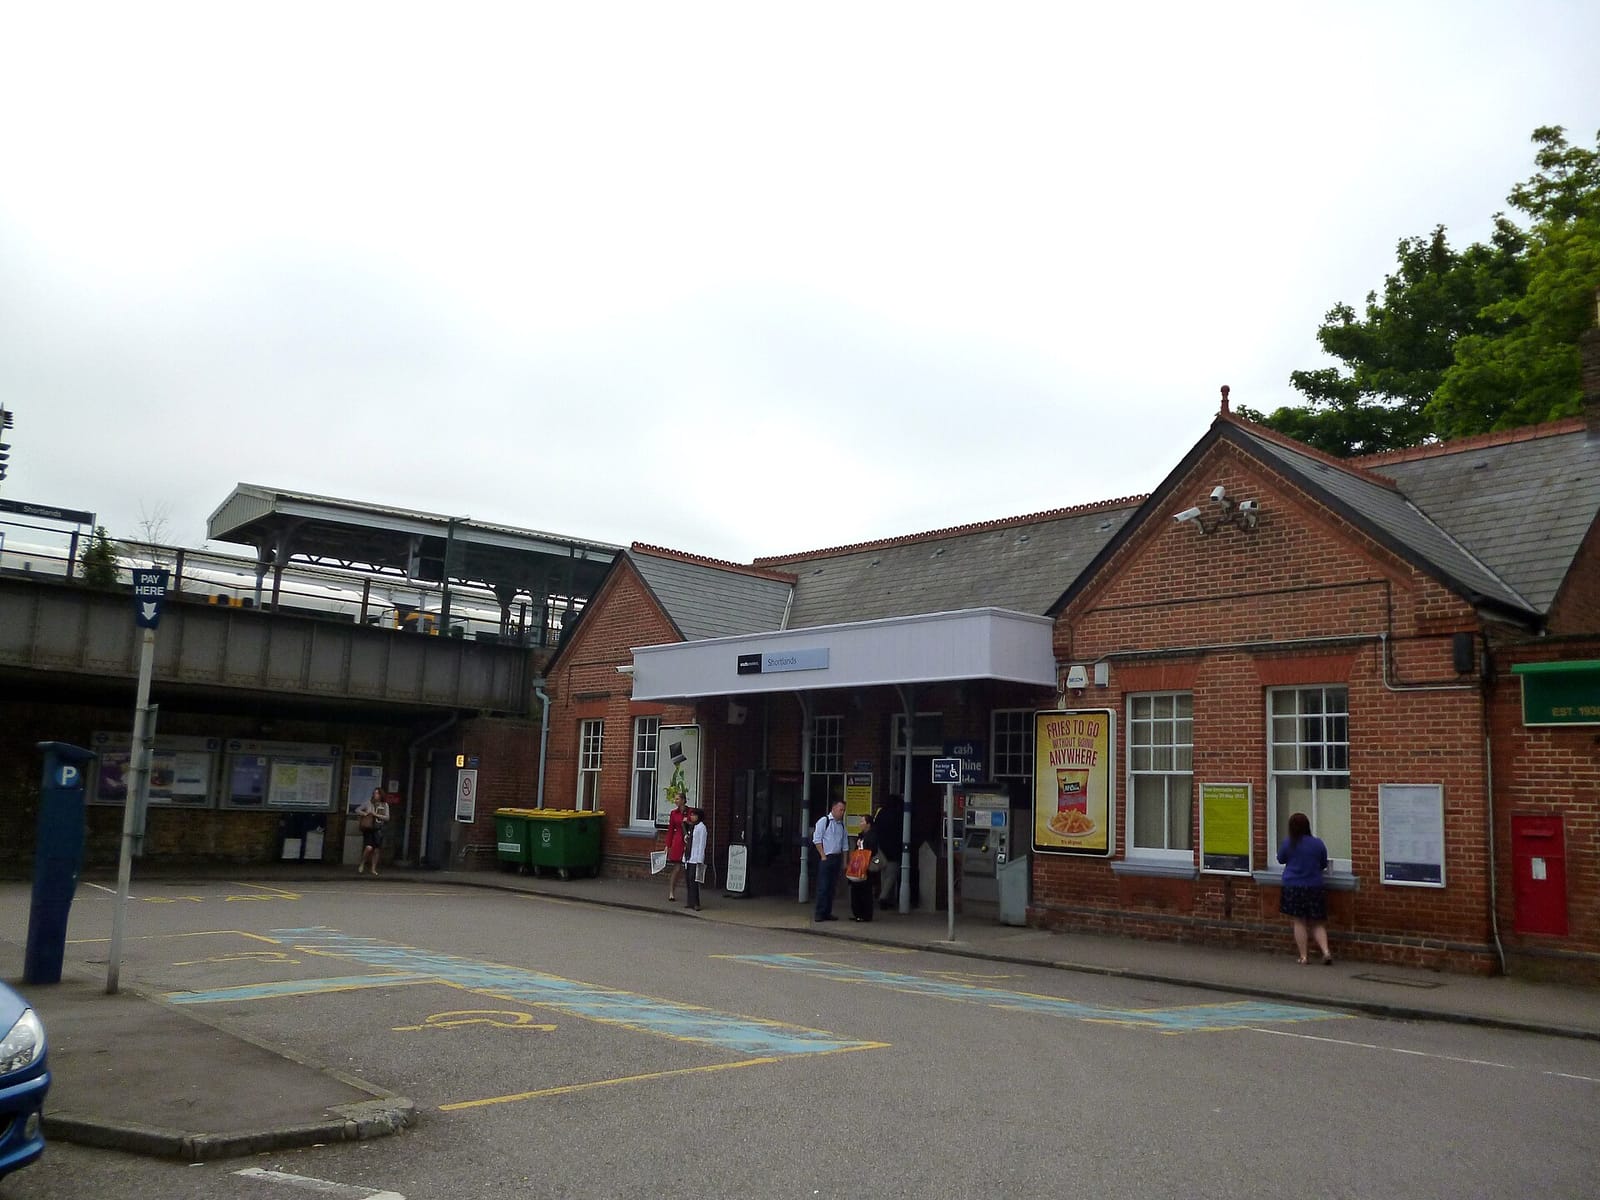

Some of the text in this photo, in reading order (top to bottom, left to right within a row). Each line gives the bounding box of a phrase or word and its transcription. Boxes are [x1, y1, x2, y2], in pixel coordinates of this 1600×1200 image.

[23, 505, 62, 517] Shortlands
[141, 574, 160, 584] PAY
[135, 585, 165, 596] HERE
[767, 656, 798, 667] Shortlands
[1046, 720, 1100, 739] FRIES TO GO
[1052, 737, 1076, 748] WITHOUT
[953, 743, 974, 755] cash
[1049, 748, 1098, 767] ANYWHERE
[962, 759, 981, 771] hine
[61, 766, 77, 785] P
